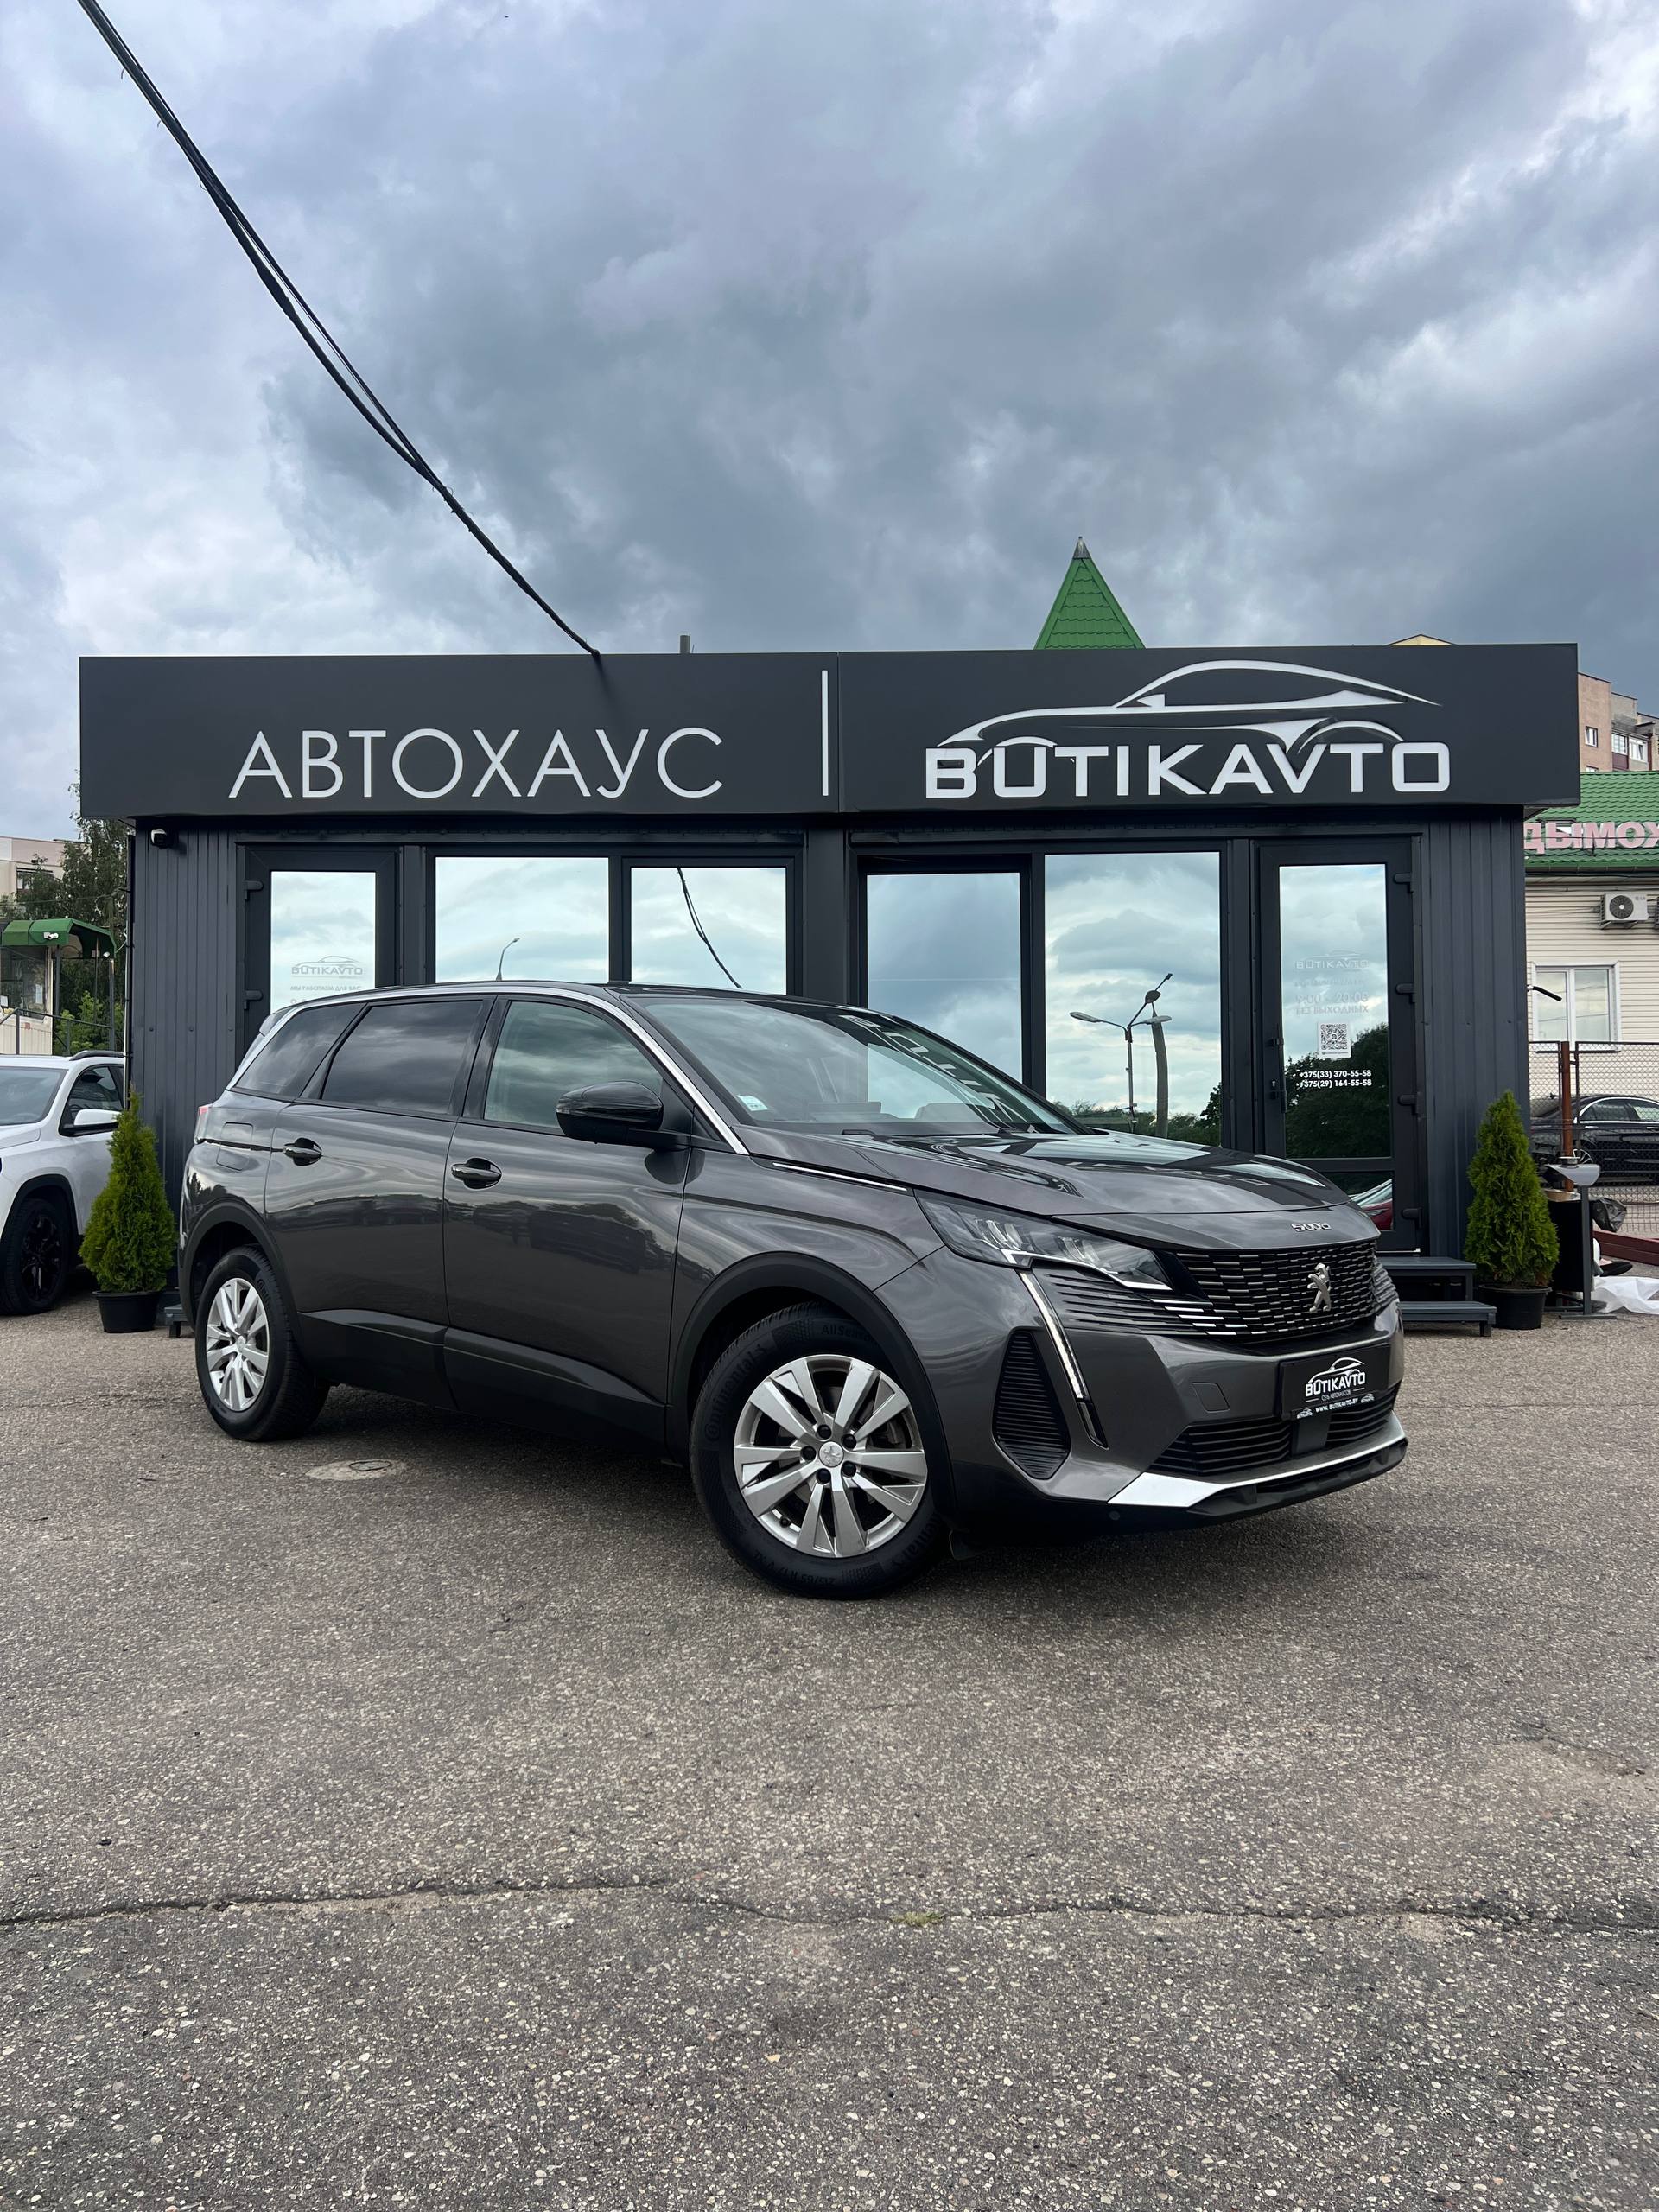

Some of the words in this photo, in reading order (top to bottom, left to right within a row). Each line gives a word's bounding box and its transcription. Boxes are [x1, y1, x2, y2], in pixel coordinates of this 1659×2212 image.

[228, 727, 723, 798] АВТОХАУС
[925, 741, 1450, 798] BUTIKAVTO
[1296, 960, 1369, 969] BUTIKAVTO
[291, 966, 363, 975] BUTIKAVTO
[1300, 1071, 1332, 1079] +375(33)
[1300, 1080, 1332, 1089] +375(29)
[1305, 1371, 1366, 1397] BUTIKAVTO
